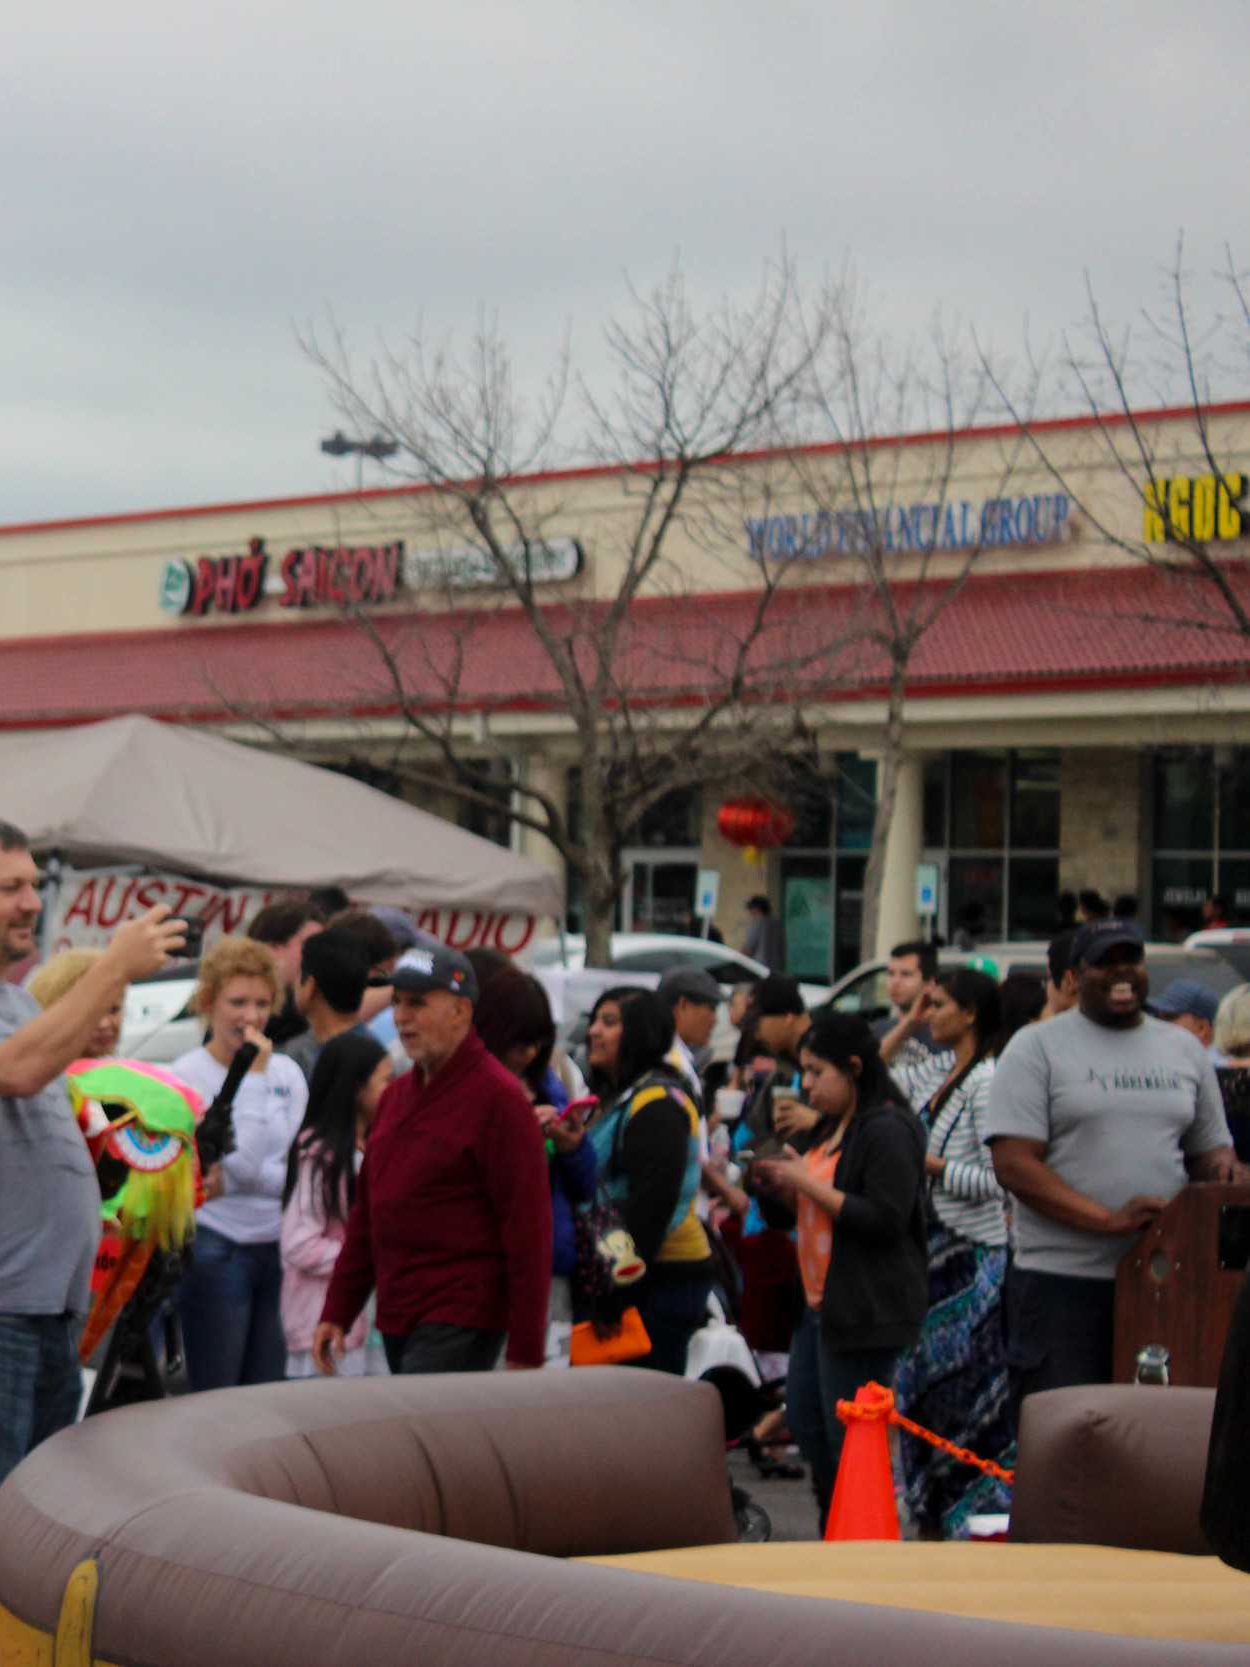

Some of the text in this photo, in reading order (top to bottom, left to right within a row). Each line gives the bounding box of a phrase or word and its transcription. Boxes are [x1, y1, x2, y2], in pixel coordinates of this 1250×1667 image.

[980, 493, 1070, 546] GROUP
[279, 542, 404, 608] SAIGON
[402, 904, 535, 955] ADIO
